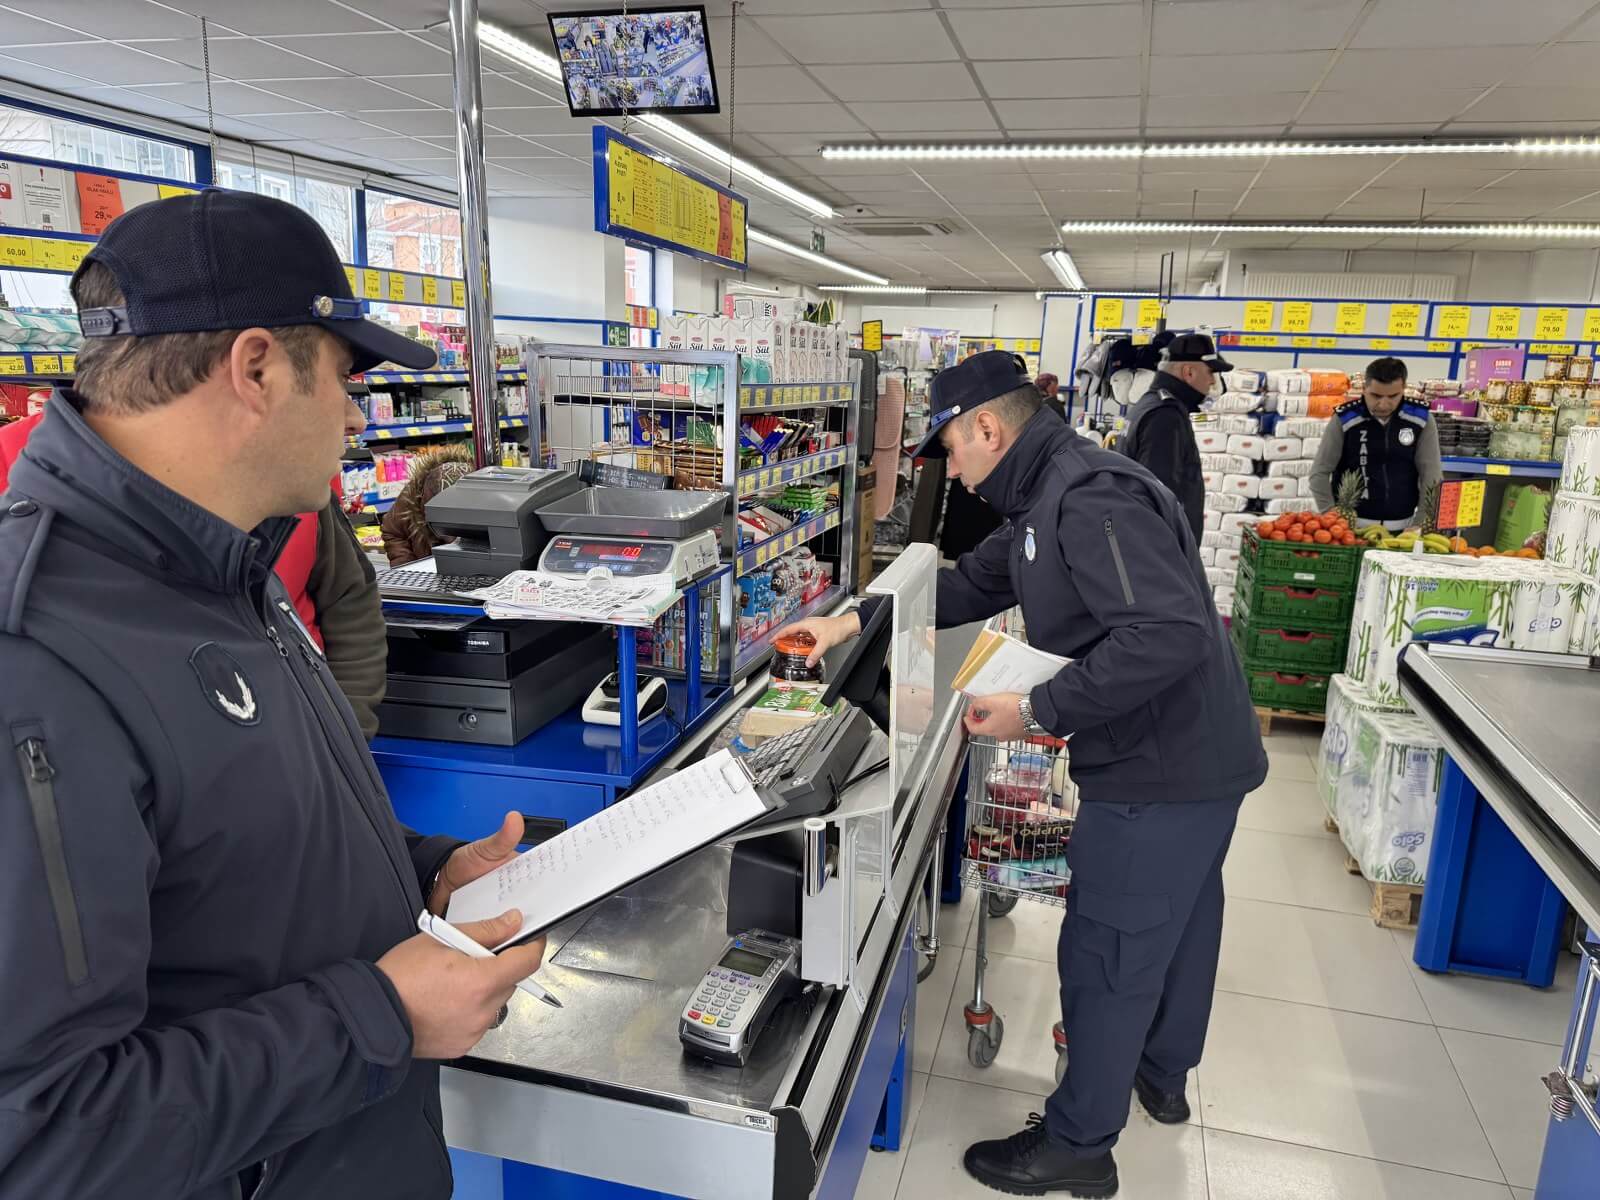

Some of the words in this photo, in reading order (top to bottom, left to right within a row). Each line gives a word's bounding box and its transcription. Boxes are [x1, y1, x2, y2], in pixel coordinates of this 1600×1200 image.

[668, 341, 682, 350] Süt
[690, 342, 704, 351] Süt
[712, 343, 725, 351] Süt
[734, 344, 748, 353] Süt
[755, 345, 770, 354] Süt
[1392, 832, 1426, 850] Solo
